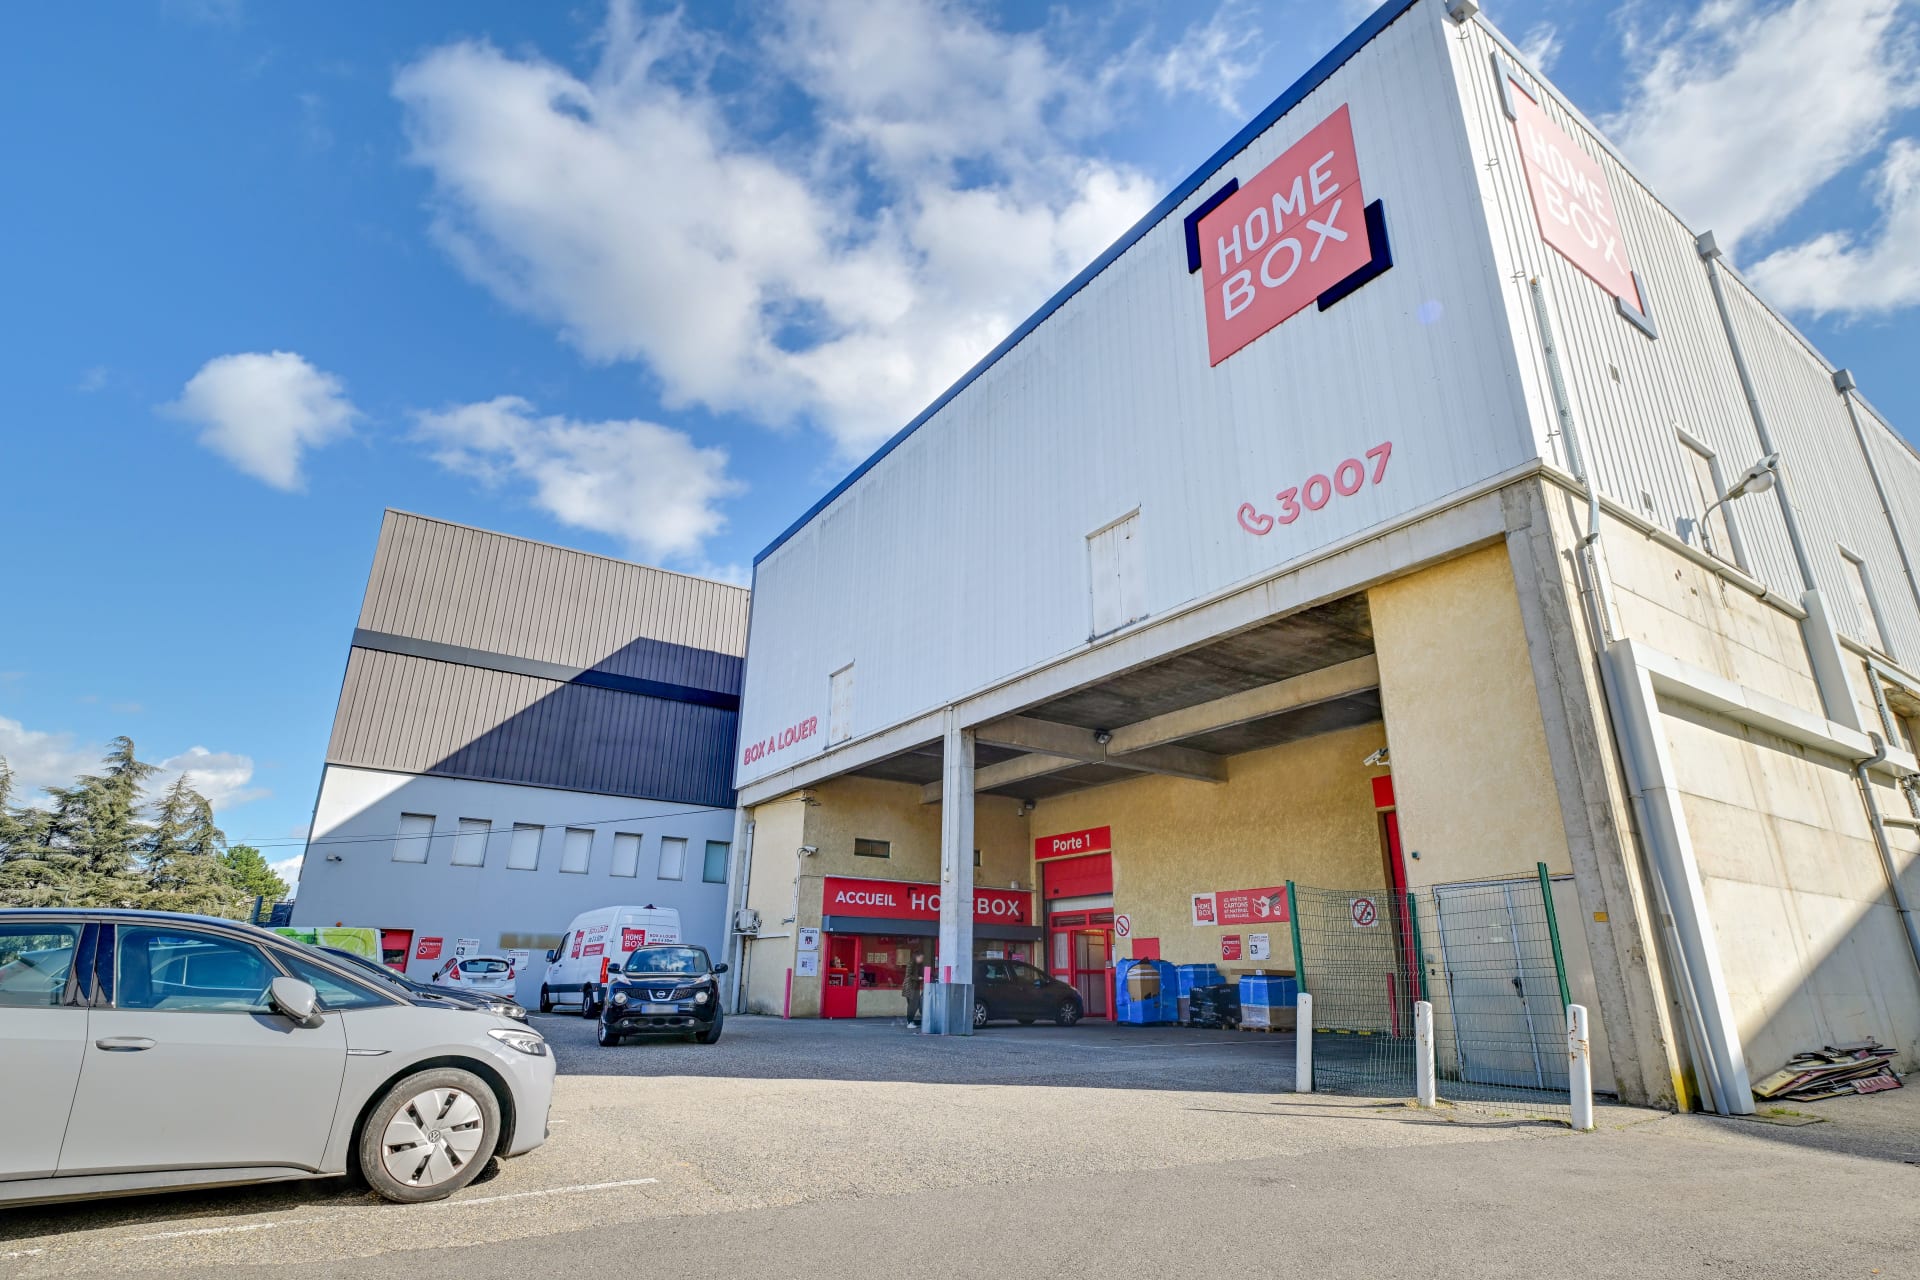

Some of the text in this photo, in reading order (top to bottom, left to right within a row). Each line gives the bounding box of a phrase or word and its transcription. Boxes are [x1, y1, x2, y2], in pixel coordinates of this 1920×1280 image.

[1528, 121, 1612, 227] HOME
[1217, 150, 1340, 275] HOME
[1538, 171, 1626, 276] BOX
[1222, 198, 1349, 321] BOX
[1276, 441, 1393, 525] 3007
[744, 716, 818, 766] BOX A LOUER
[1053, 833, 1091, 853] Porte 1
[835, 890, 897, 907] ACCUEIL
[1197, 902, 1211, 910] HOME
[624, 940, 643, 948] BOX
[625, 933, 644, 941] HOME
